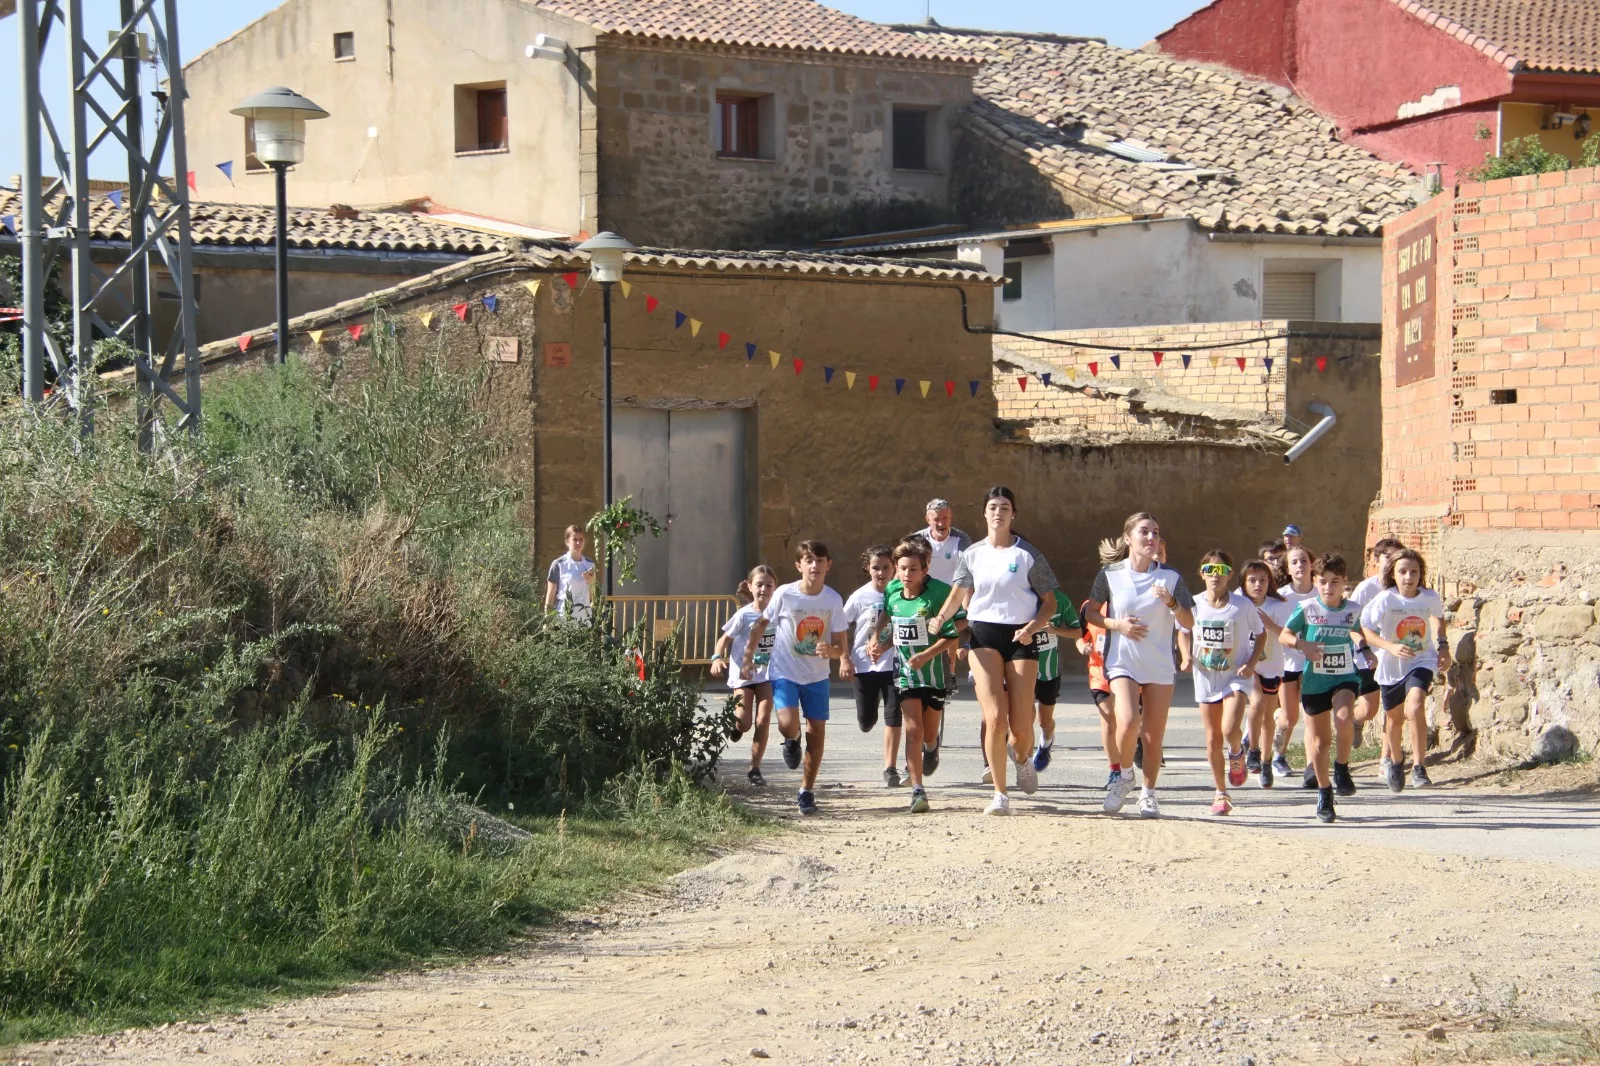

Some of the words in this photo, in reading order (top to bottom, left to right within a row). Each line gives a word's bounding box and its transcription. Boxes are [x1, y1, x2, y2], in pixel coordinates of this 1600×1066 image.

[899, 627, 916, 638] 571
[1203, 628, 1224, 640] 483
[760, 636, 775, 646] 485
[1324, 655, 1345, 667] 484
